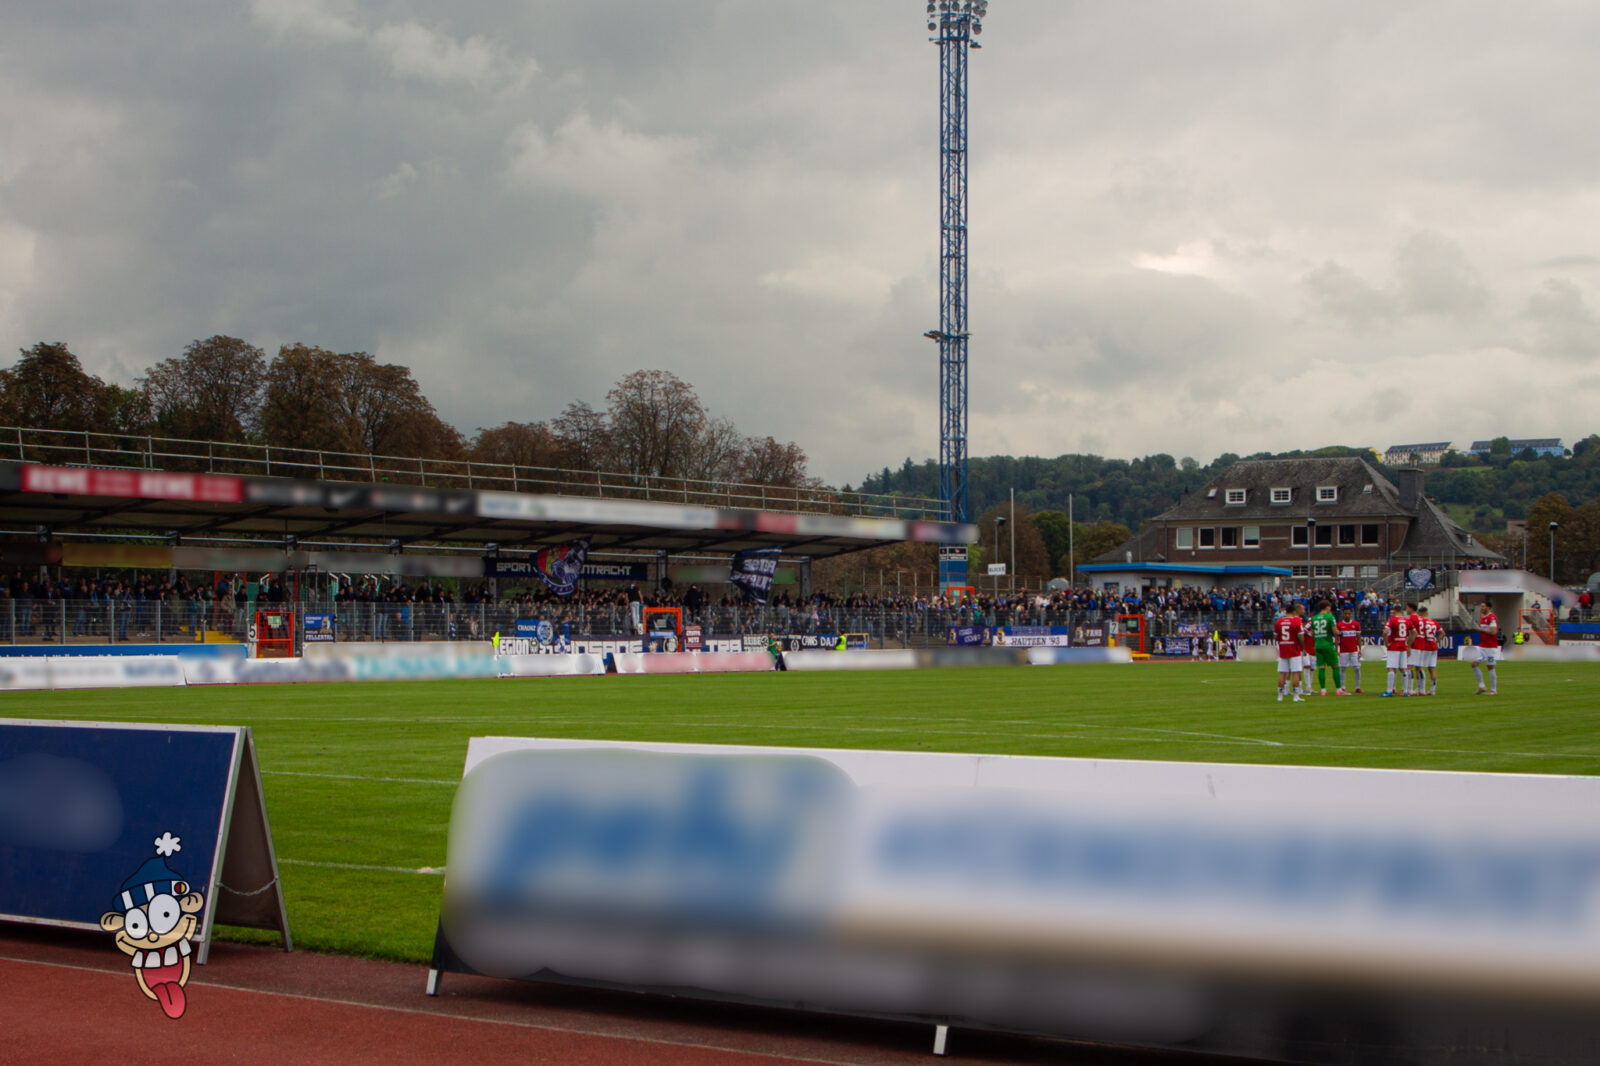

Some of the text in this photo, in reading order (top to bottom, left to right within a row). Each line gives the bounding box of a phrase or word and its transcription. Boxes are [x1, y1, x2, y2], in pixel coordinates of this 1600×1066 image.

[249, 624, 256, 639] 5
[1281, 625, 1290, 641] 5
[1313, 619, 1327, 635] 32
[1398, 624, 1406, 638] 8
